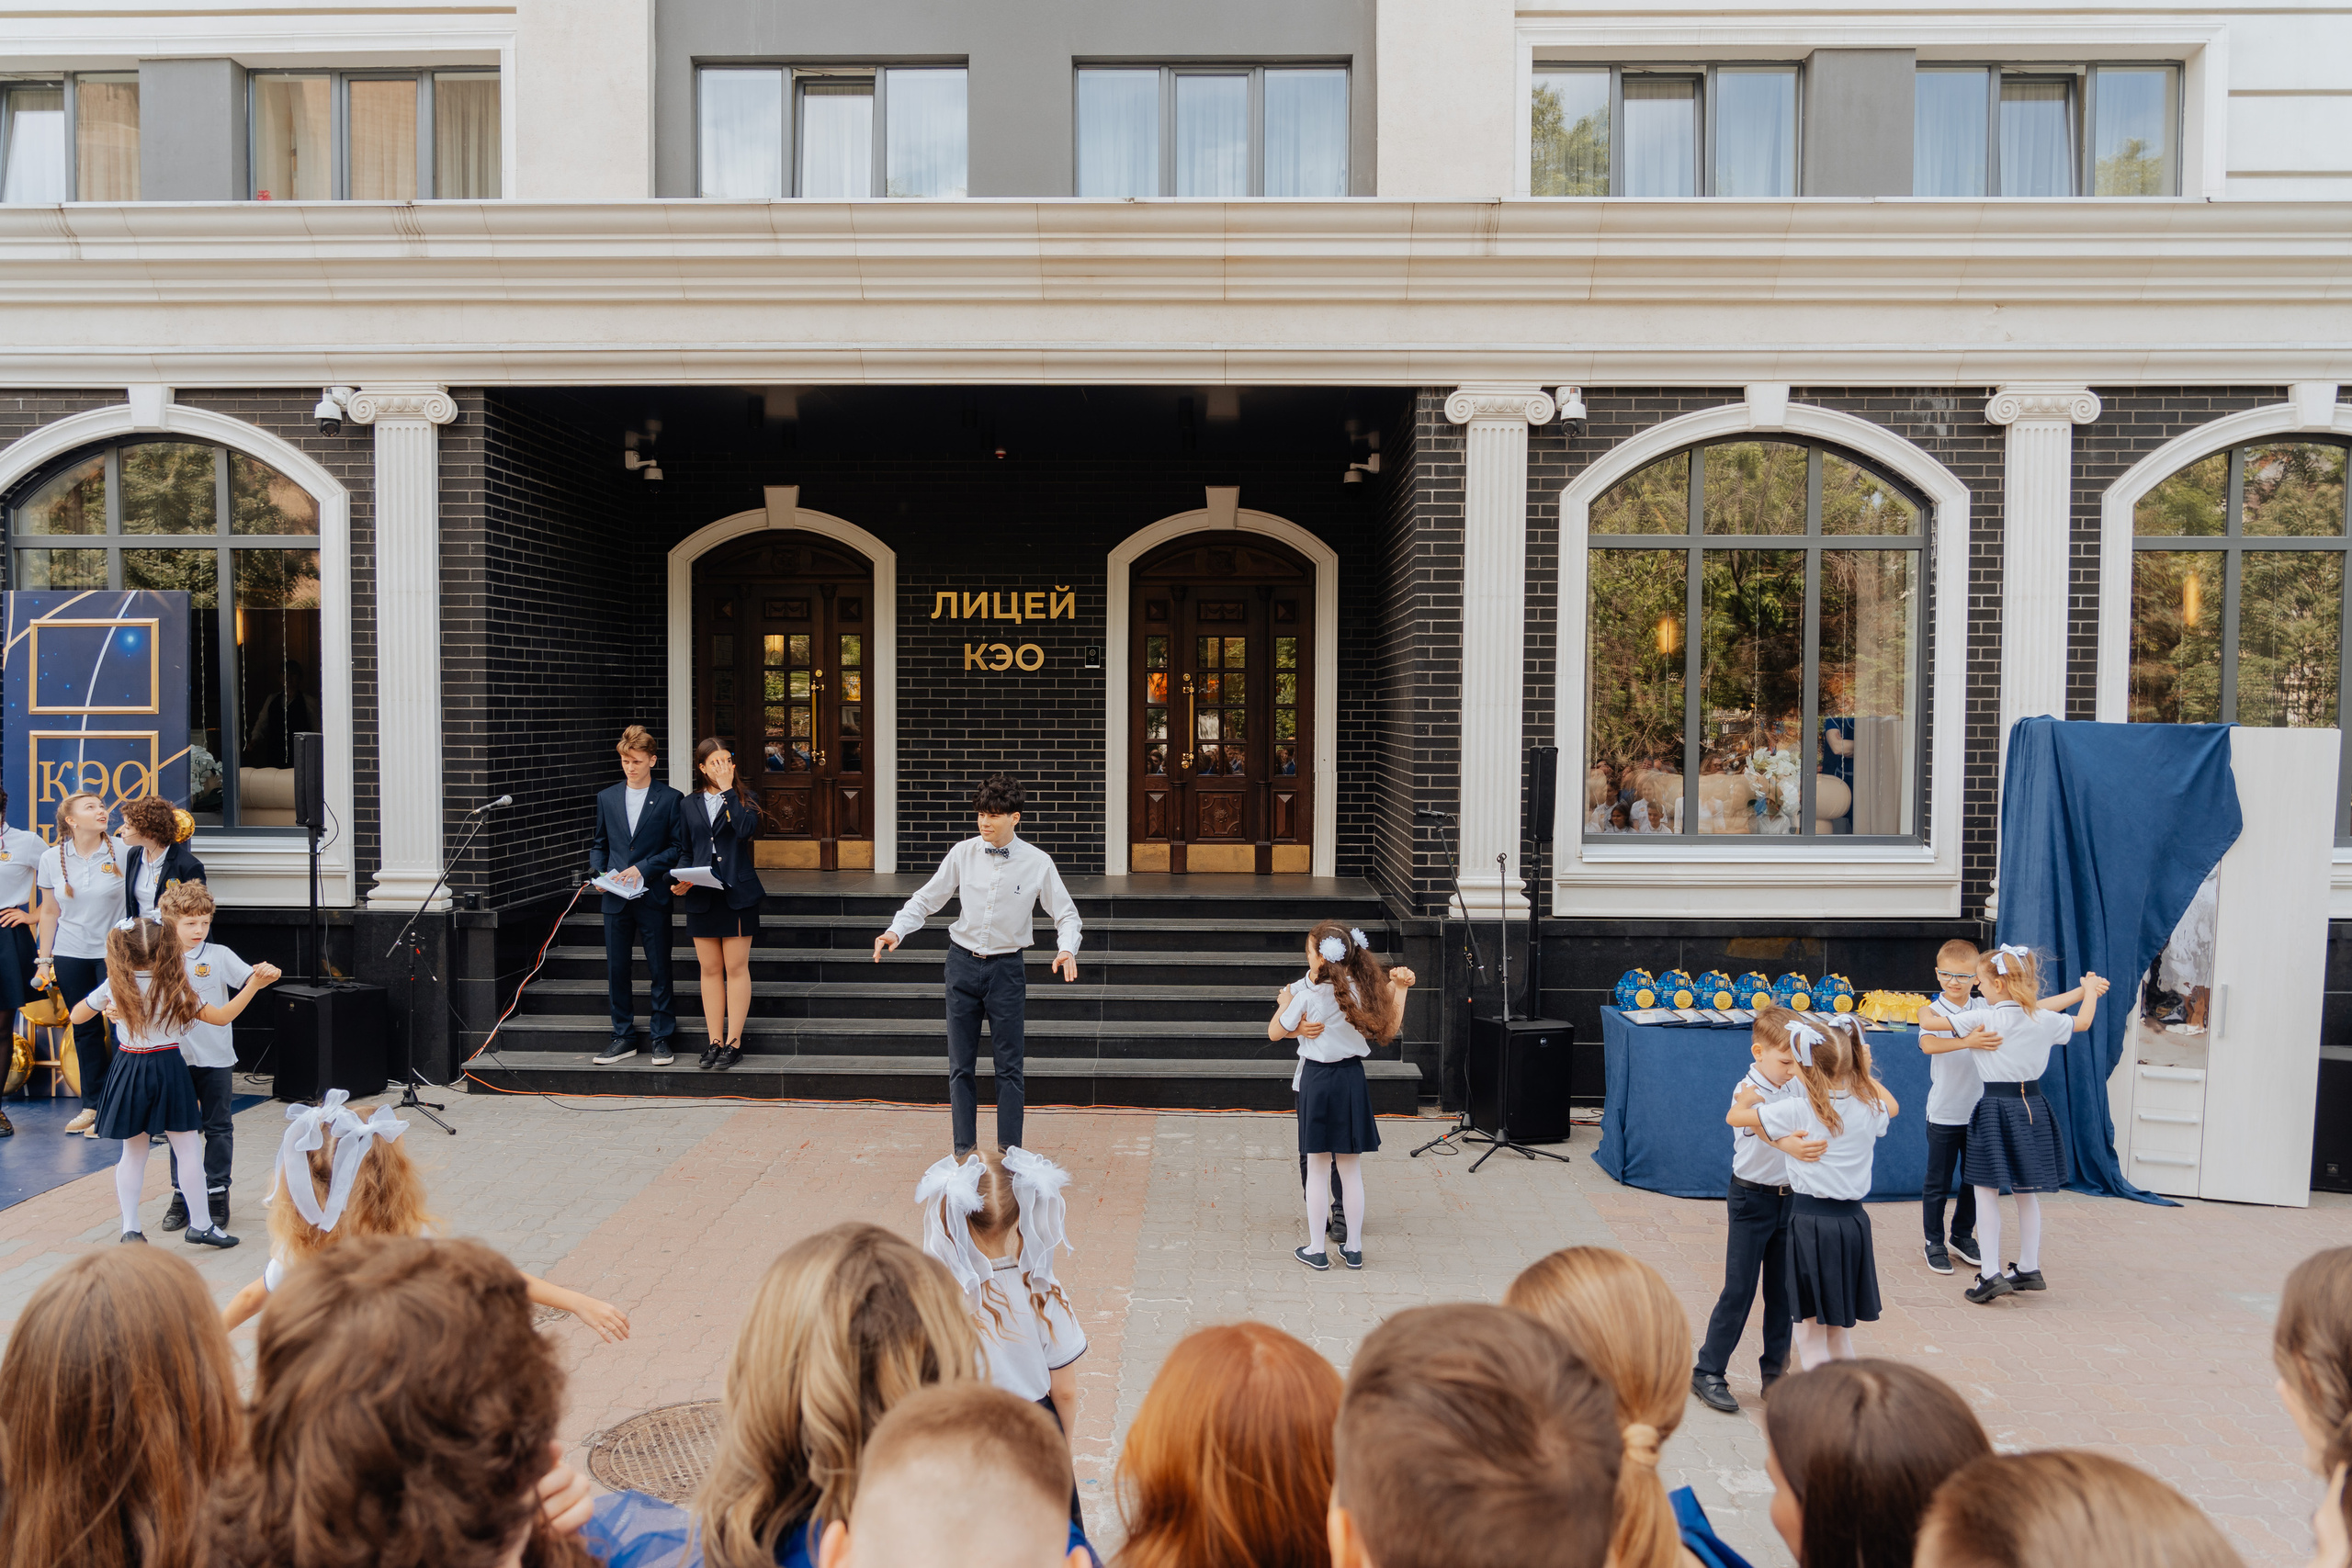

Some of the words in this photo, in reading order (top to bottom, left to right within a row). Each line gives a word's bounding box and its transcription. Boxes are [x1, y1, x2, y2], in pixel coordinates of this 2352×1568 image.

[931, 585, 1076, 625] ЛИЦЕЙ
[964, 643, 1045, 671] КЭО
[38, 760, 151, 803] КЭО
